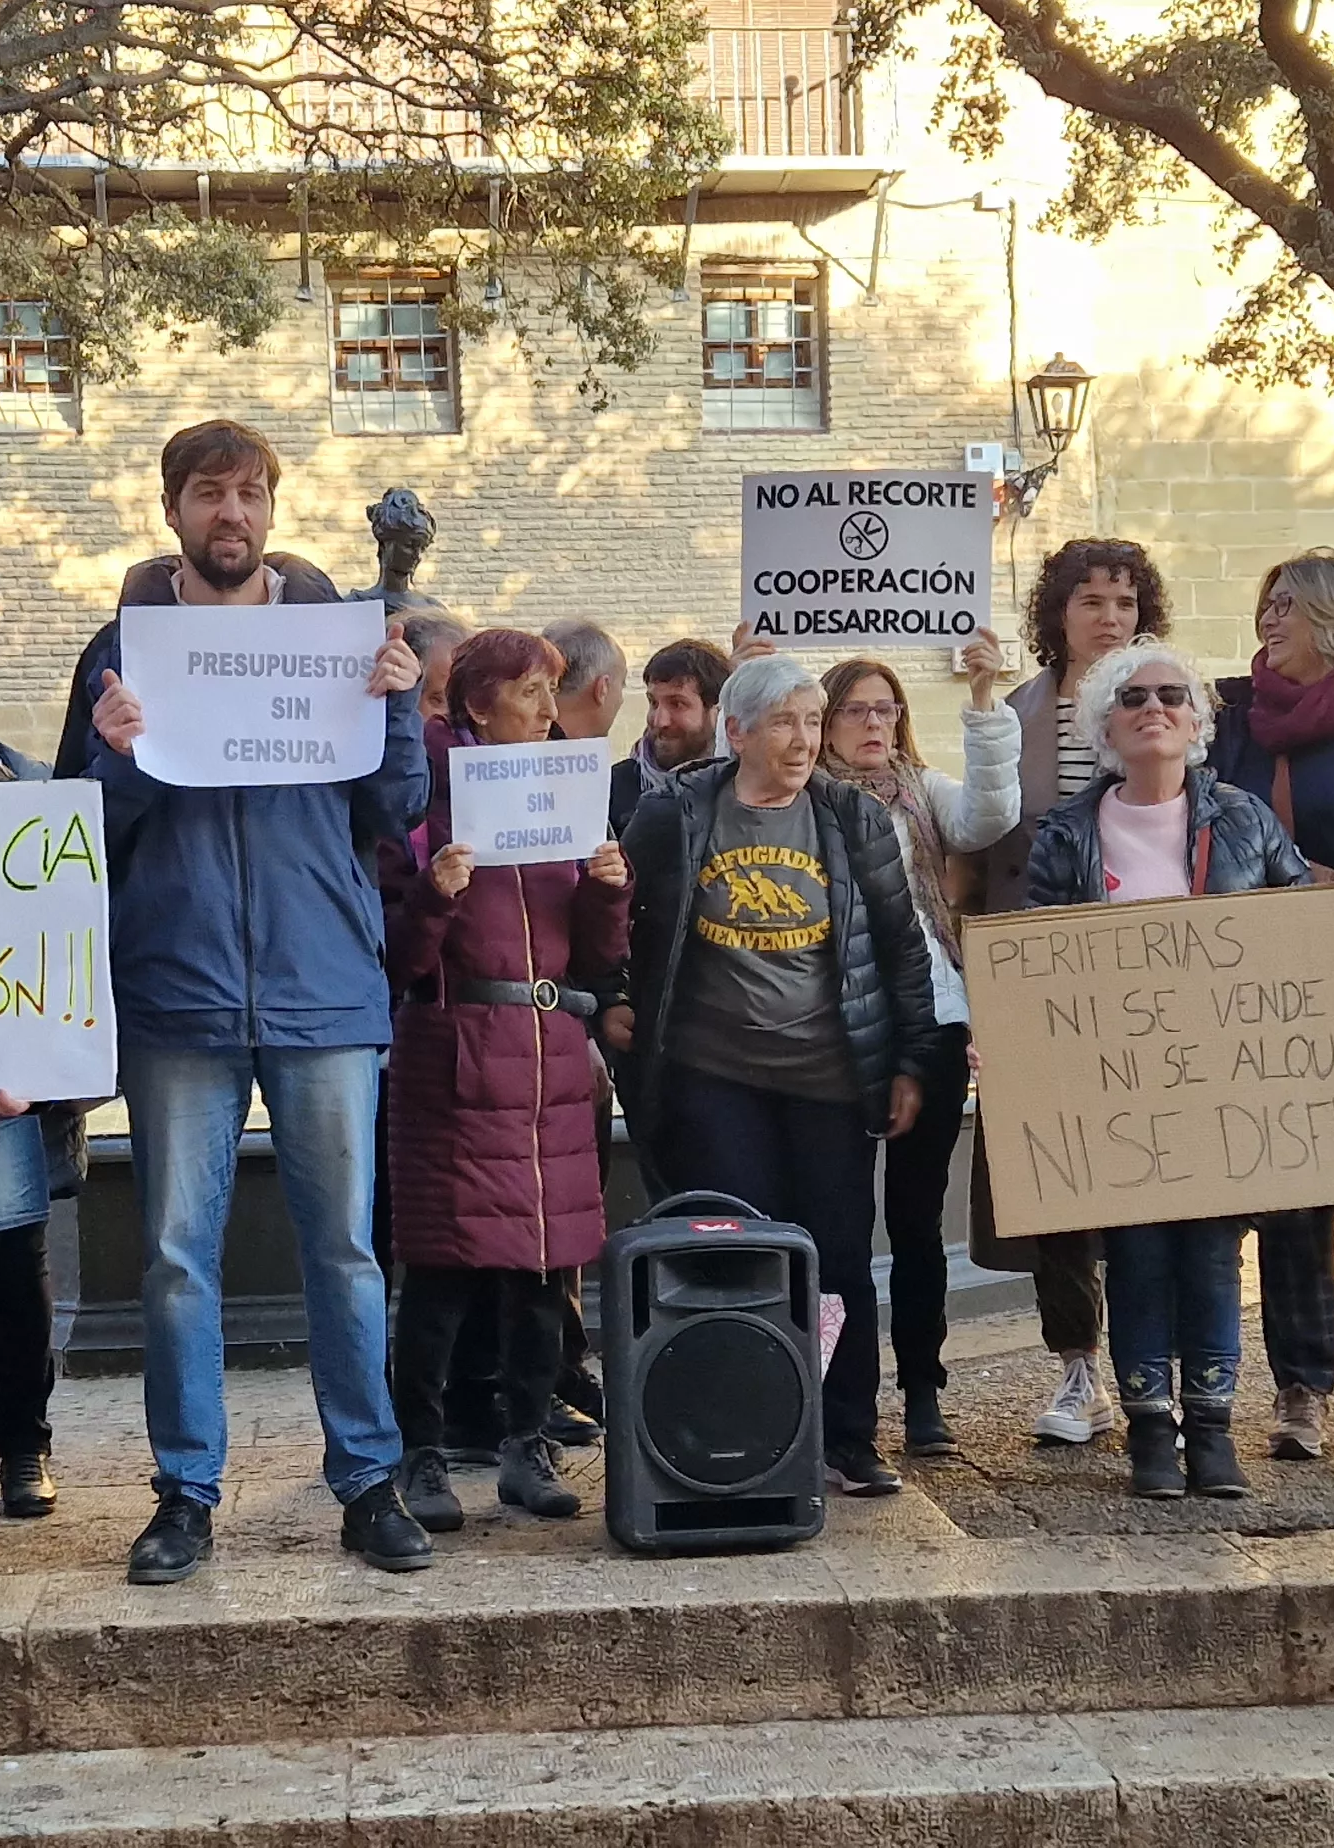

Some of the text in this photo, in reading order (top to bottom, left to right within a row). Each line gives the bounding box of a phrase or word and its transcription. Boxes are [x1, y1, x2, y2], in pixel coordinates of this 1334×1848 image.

[756, 480, 977, 509] NO AL RECORTE
[753, 561, 975, 596] COOPERACIÓN
[753, 609, 976, 636] AL DESARROLLO
[187, 650, 373, 679] PRESUPUESTOS
[270, 696, 311, 721] SIN
[223, 738, 336, 764] CENSURA
[464, 753, 599, 782] PRESUPUESTOS
[527, 792, 555, 813] SIN
[494, 825, 573, 850] CENSURA
[987, 914, 1245, 980] PERIFERIAS
[1045, 978, 1326, 1038] NI SE VENDE
[1099, 1047, 1142, 1093] NI
[1164, 1043, 1208, 1089] SE
[1022, 1110, 1094, 1203] NI
[1105, 1109, 1194, 1189] SE
